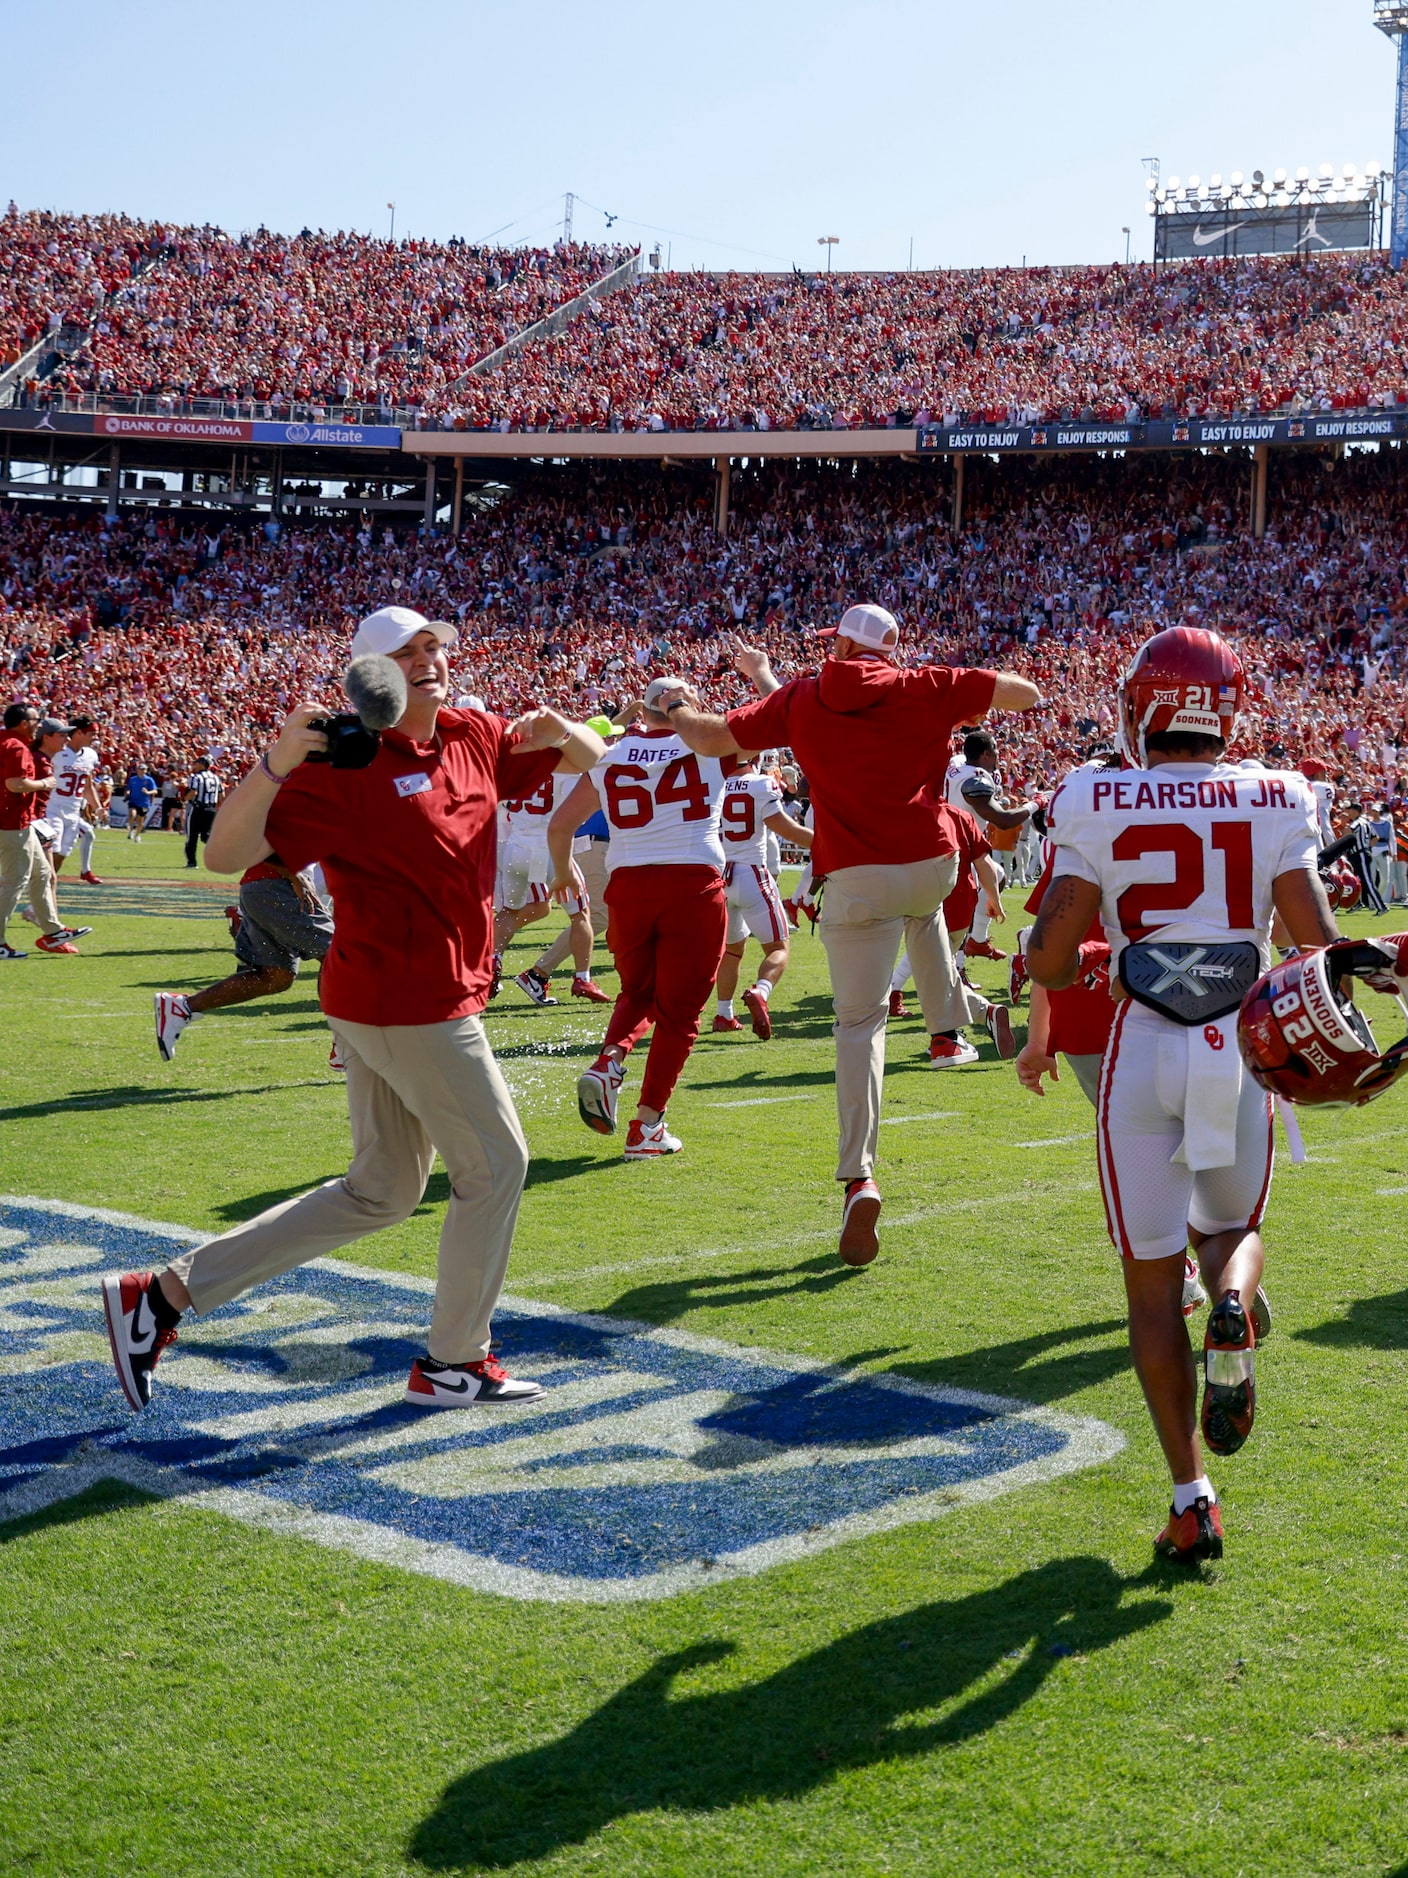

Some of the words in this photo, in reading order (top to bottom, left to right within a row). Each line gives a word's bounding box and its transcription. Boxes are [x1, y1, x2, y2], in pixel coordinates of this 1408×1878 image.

[1395, 190, 1407, 235] Allstate
[121, 420, 155, 432] BANK
[156, 422, 173, 433] OF
[174, 423, 242, 436] OKLAHOMA
[310, 429, 363, 443] Allstate
[1057, 431, 1085, 445] ENJOY
[1201, 426, 1227, 440] EASY
[1227, 426, 1242, 440] TO
[1243, 424, 1275, 439] ENJOY
[1315, 423, 1345, 437] ENJOY
[949, 433, 974, 448] EASY
[975, 433, 987, 447] TO
[988, 432, 1019, 447] ENJOY
[1185, 685, 1212, 711] 21
[1176, 715, 1219, 728] SOONERS
[604, 752, 711, 829] 64
[1093, 781, 1238, 811] PEARSON
[1251, 779, 1297, 809] JR.
[1112, 821, 1255, 945] 21
[1303, 967, 1344, 1039] SOONERS
[1272, 991, 1315, 1045] 28
